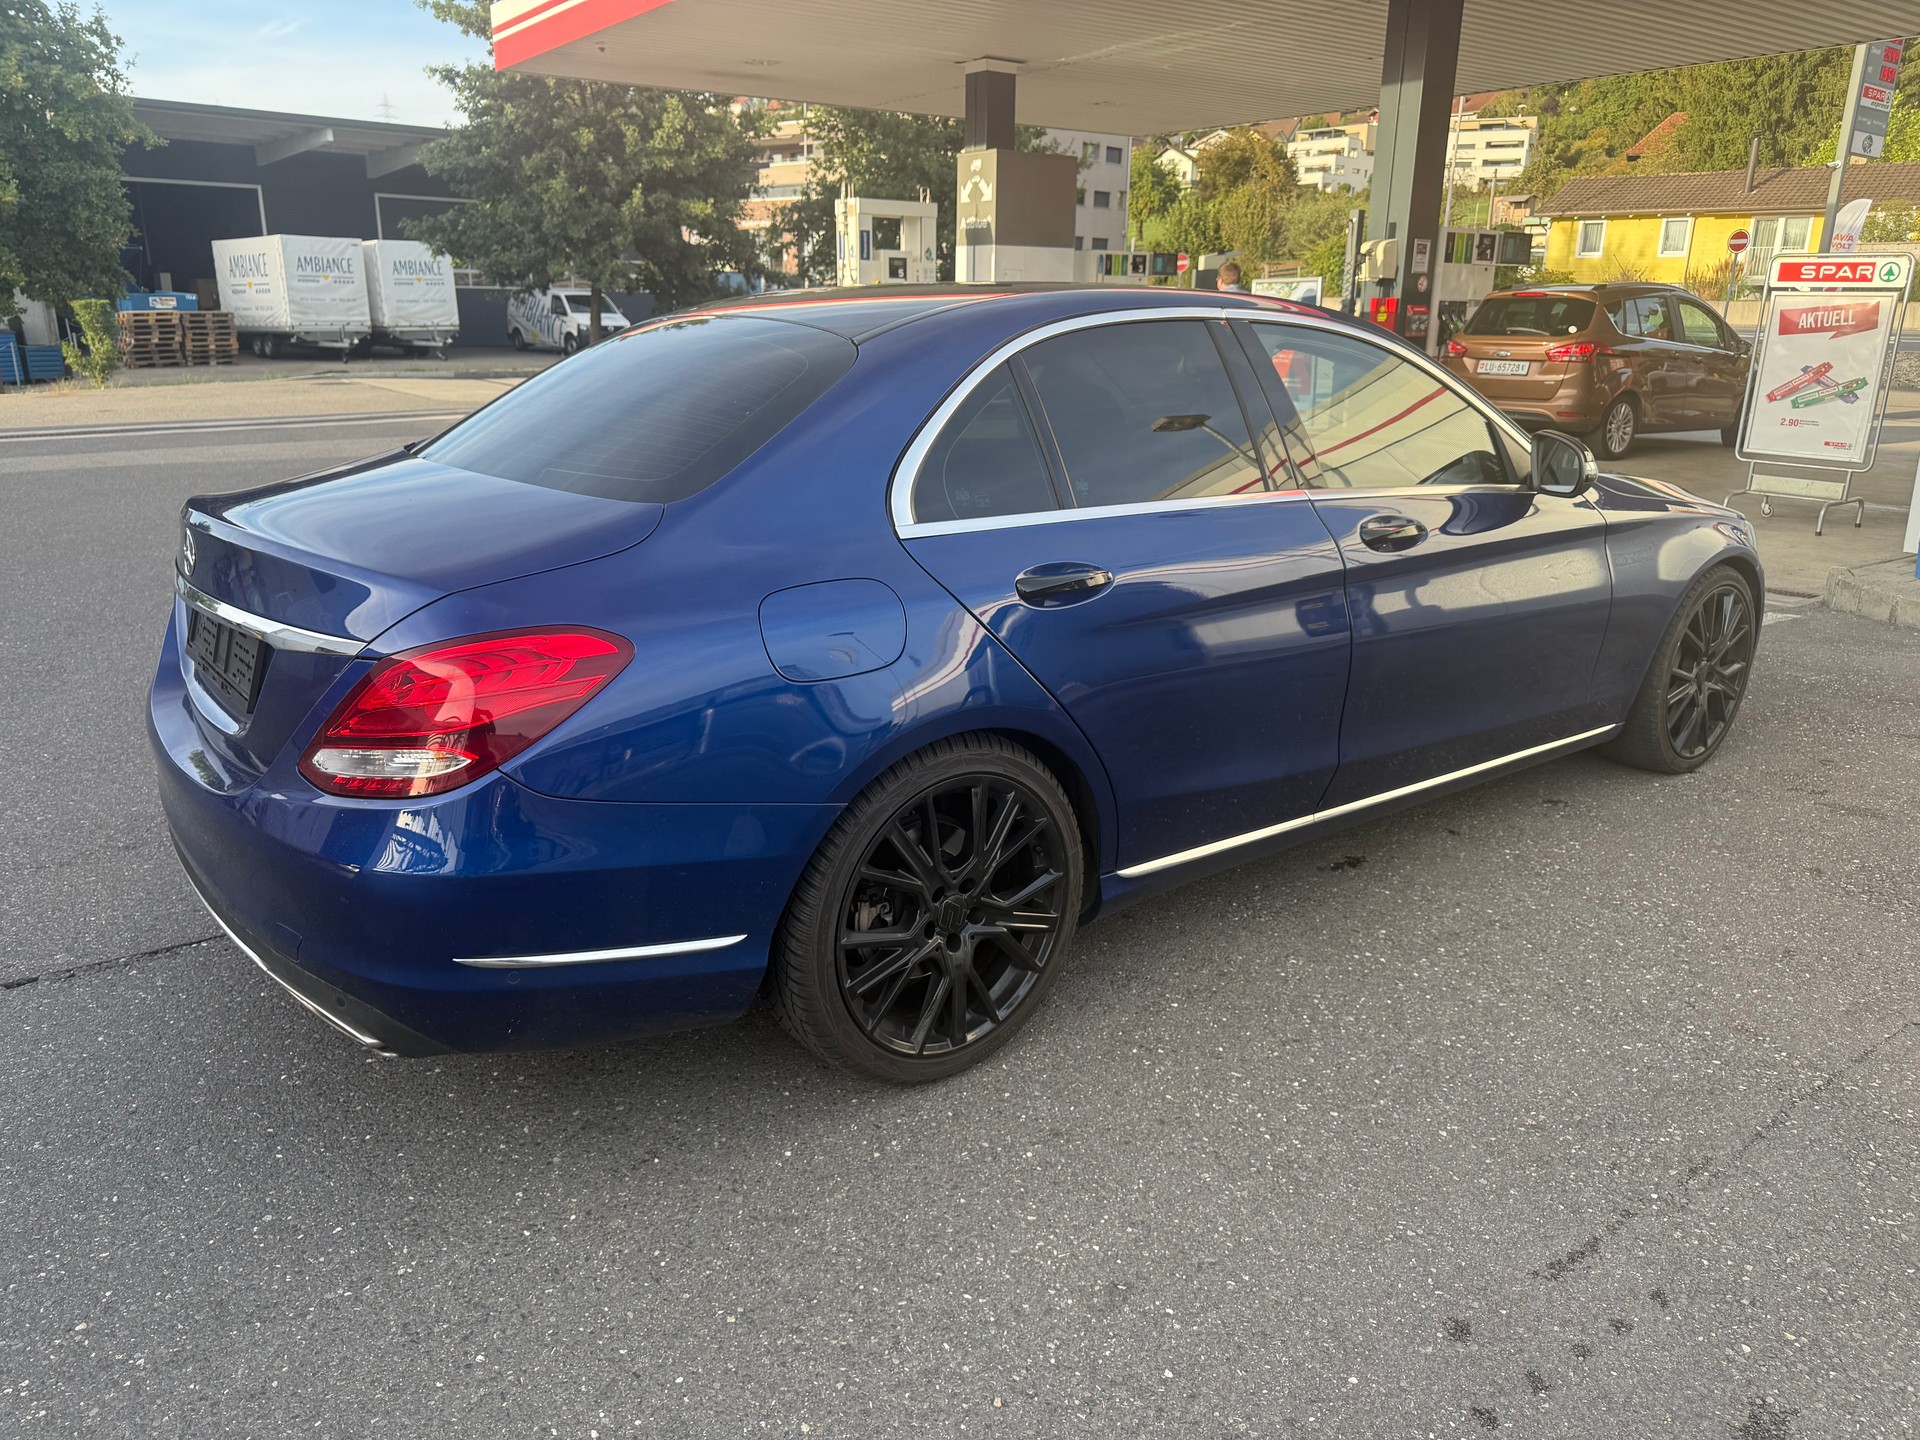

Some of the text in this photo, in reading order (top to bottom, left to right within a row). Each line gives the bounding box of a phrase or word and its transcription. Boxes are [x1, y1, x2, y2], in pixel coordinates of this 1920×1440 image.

[1867, 89, 1886, 100] SPAR
[1870, 101, 1889, 109] express
[1833, 233, 1854, 242] AVIA
[1831, 242, 1852, 250] VOLT
[229, 253, 268, 279] AMBIANCE
[296, 256, 354, 274] AMBIANCE
[392, 259, 444, 276] AMBIANCE
[897, 268, 904, 278] 5
[1800, 265, 1874, 279] SPAR
[1798, 309, 1856, 329] AKTUELL
[1780, 418, 1799, 427] 2.90
